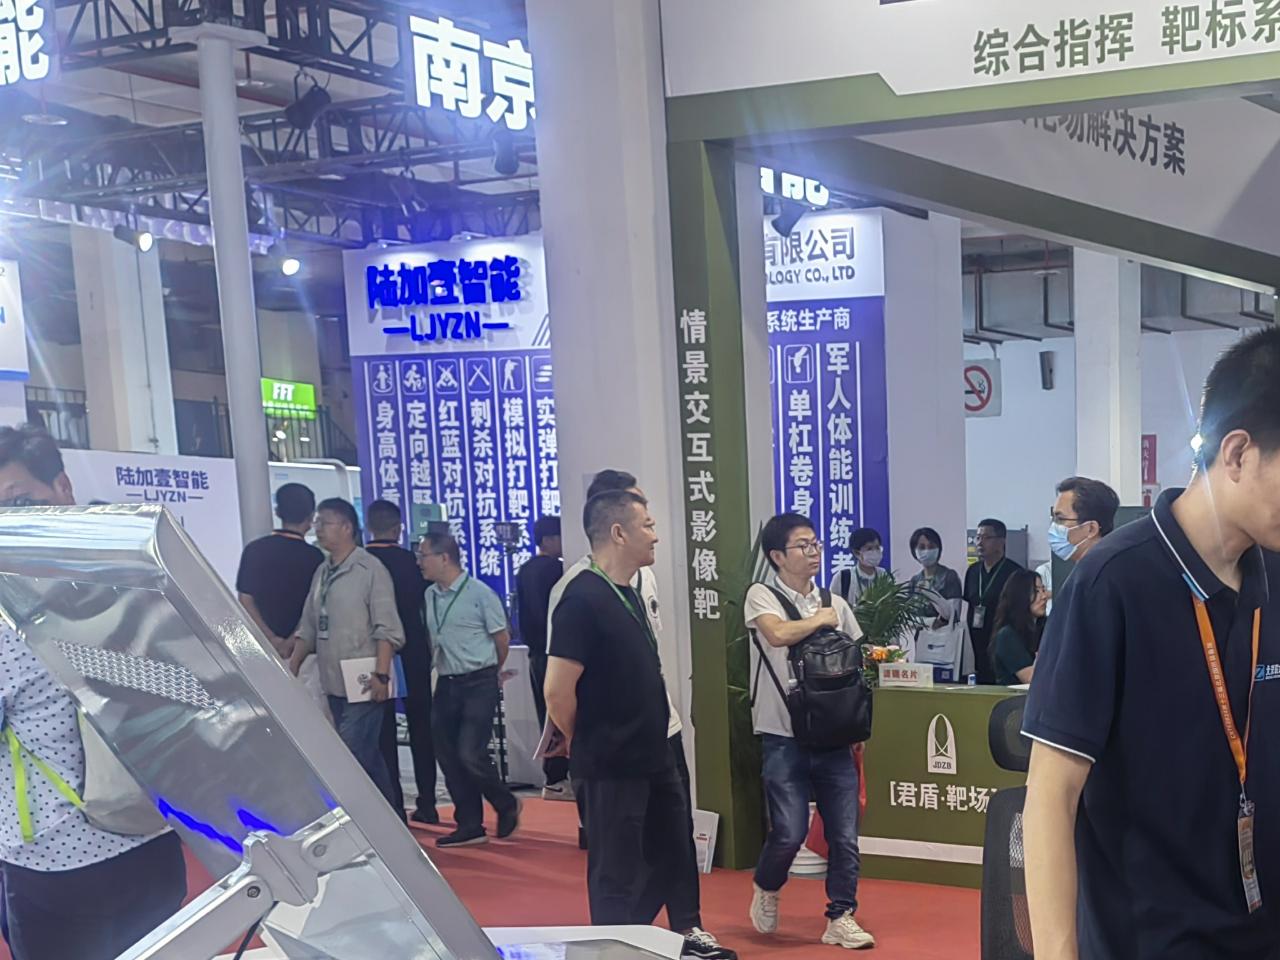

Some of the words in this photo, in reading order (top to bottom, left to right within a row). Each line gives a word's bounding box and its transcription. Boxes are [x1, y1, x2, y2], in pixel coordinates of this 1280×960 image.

[973, 12, 1135, 77] 综合指挥
[409, 15, 537, 130] 南京
[367, 255, 520, 309] 陆加壹智能
[765, 270, 801, 285] LOGY
[832, 265, 856, 281] LTD
[410, 311, 481, 341] LJYZN
[116, 466, 209, 490] 陆加壹智能
[680, 309, 720, 620] 情景交互式影像靶
[144, 490, 186, 503] LJYZN
[932, 761, 952, 770] JDZB
[889, 781, 998, 813] [君盾·靶场
